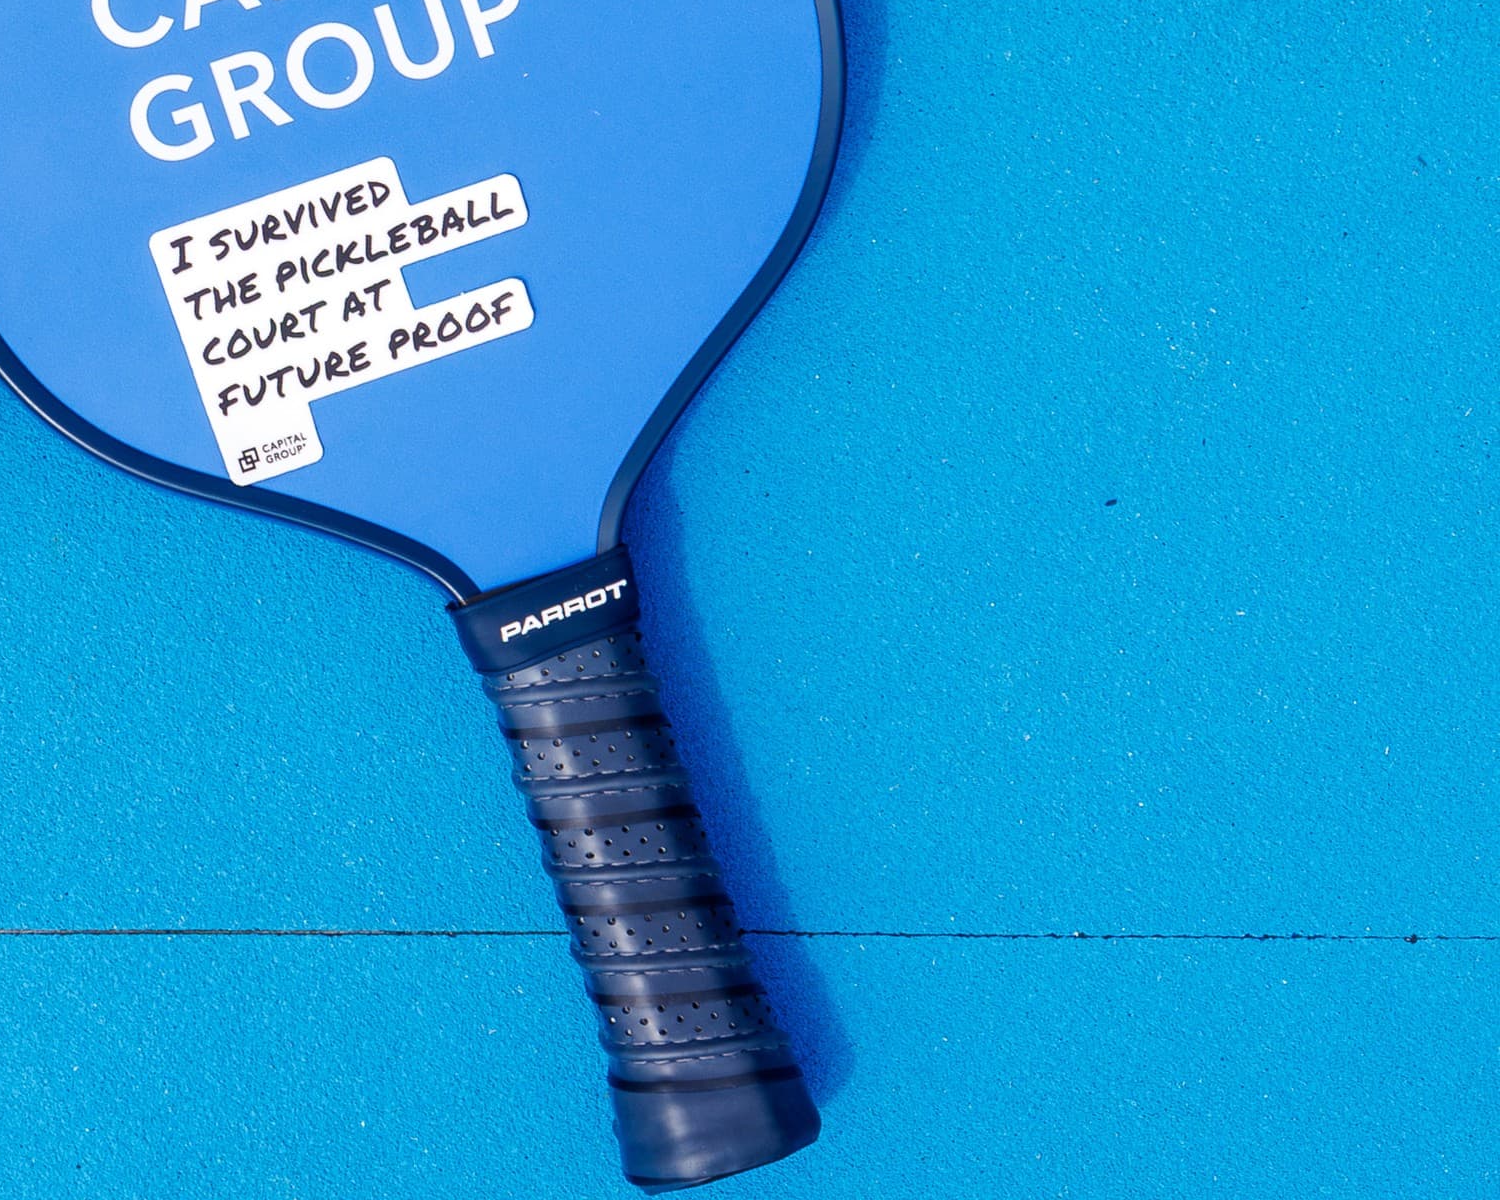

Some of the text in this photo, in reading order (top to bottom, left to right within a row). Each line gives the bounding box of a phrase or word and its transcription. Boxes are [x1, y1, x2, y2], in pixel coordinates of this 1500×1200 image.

[170, 181, 391, 275] I SURVIVED
[184, 192, 514, 320] THE PICKLEBALL
[202, 279, 392, 366] COURT AT
[217, 292, 514, 416] FUTURE PROOF
[262, 432, 307, 453] CAPITAL
[500, 579, 627, 643] PARROT
